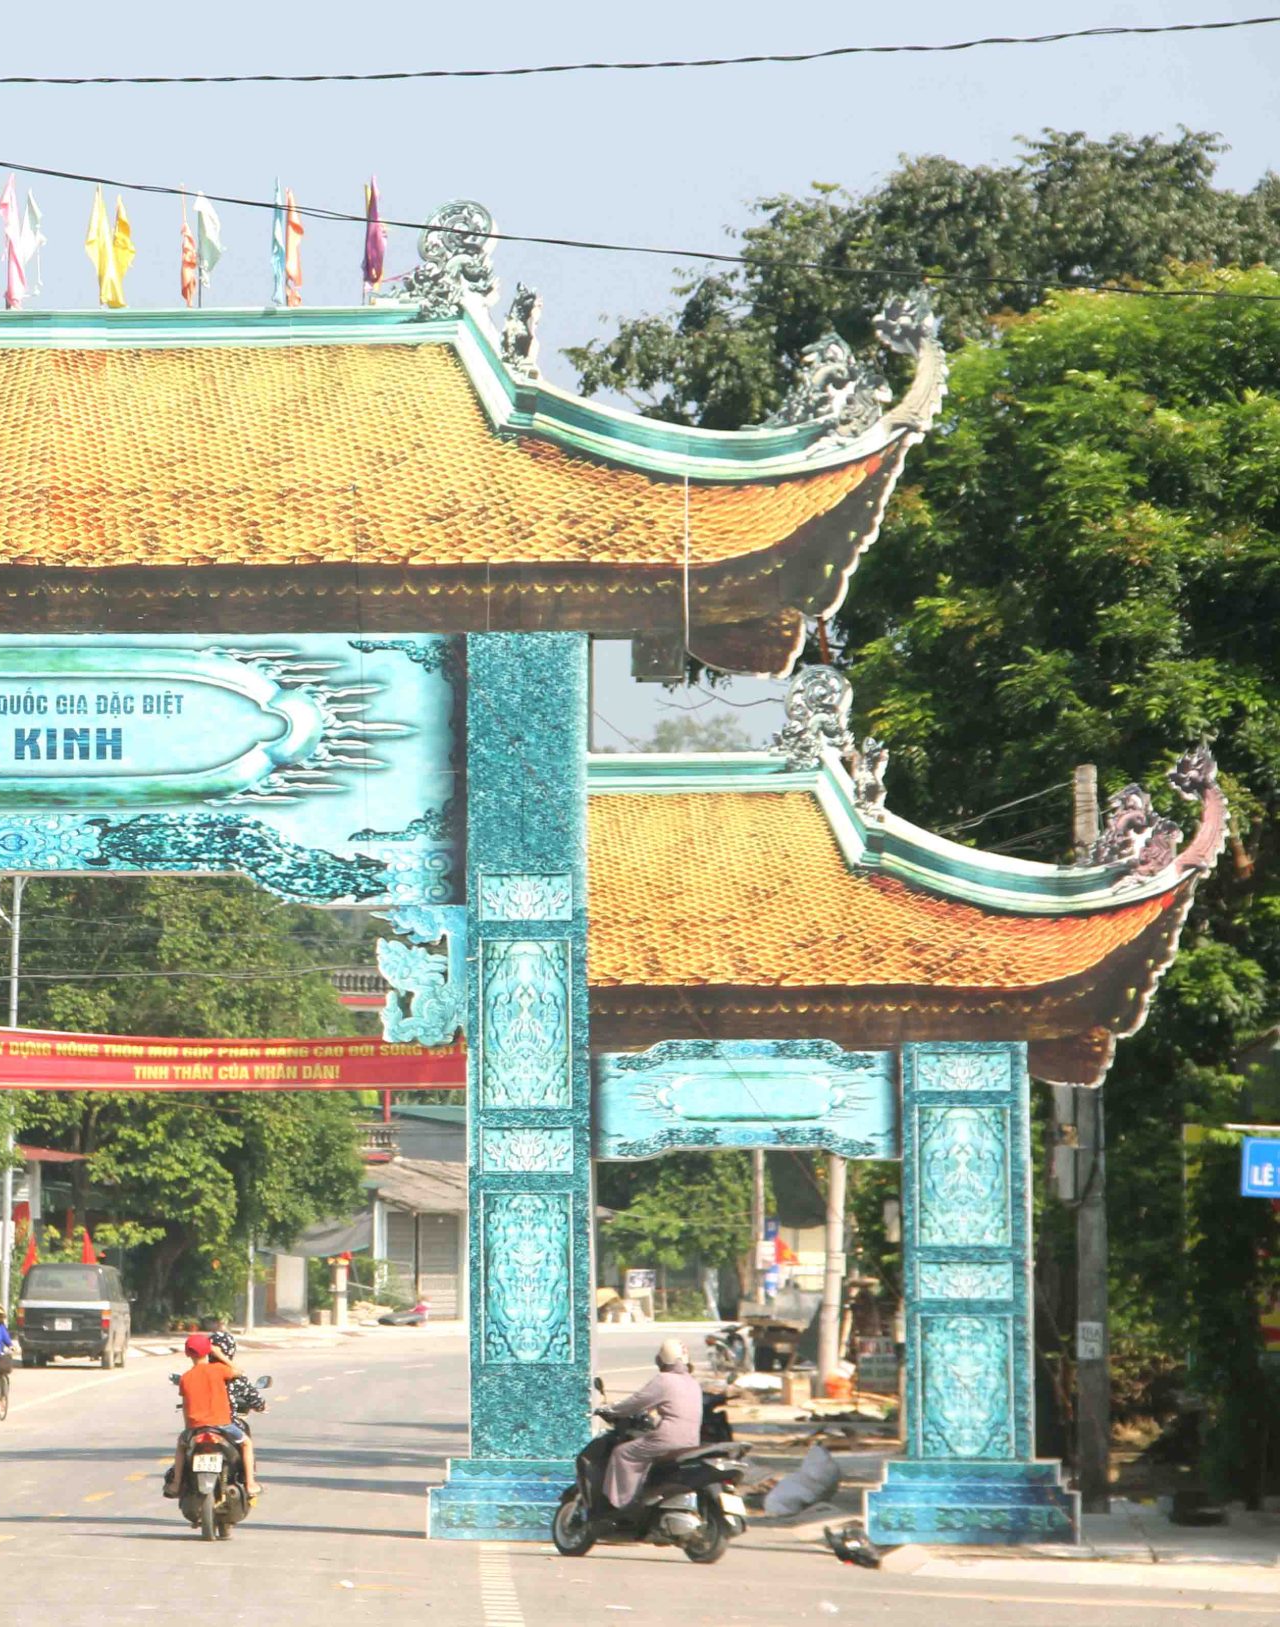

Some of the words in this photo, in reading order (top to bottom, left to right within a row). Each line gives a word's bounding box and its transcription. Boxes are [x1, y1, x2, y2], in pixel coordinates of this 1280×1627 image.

[55, 694, 88, 716] GIA
[95, 690, 135, 720] ĐẶC
[142, 690, 185, 720] BIỆT
[14, 727, 123, 761] KINH
[133, 1064, 169, 1081] TINH
[218, 1062, 249, 1080] CỦA
[254, 1063, 298, 1080] NHÂN
[1250, 1162, 1275, 1187] LÊ
